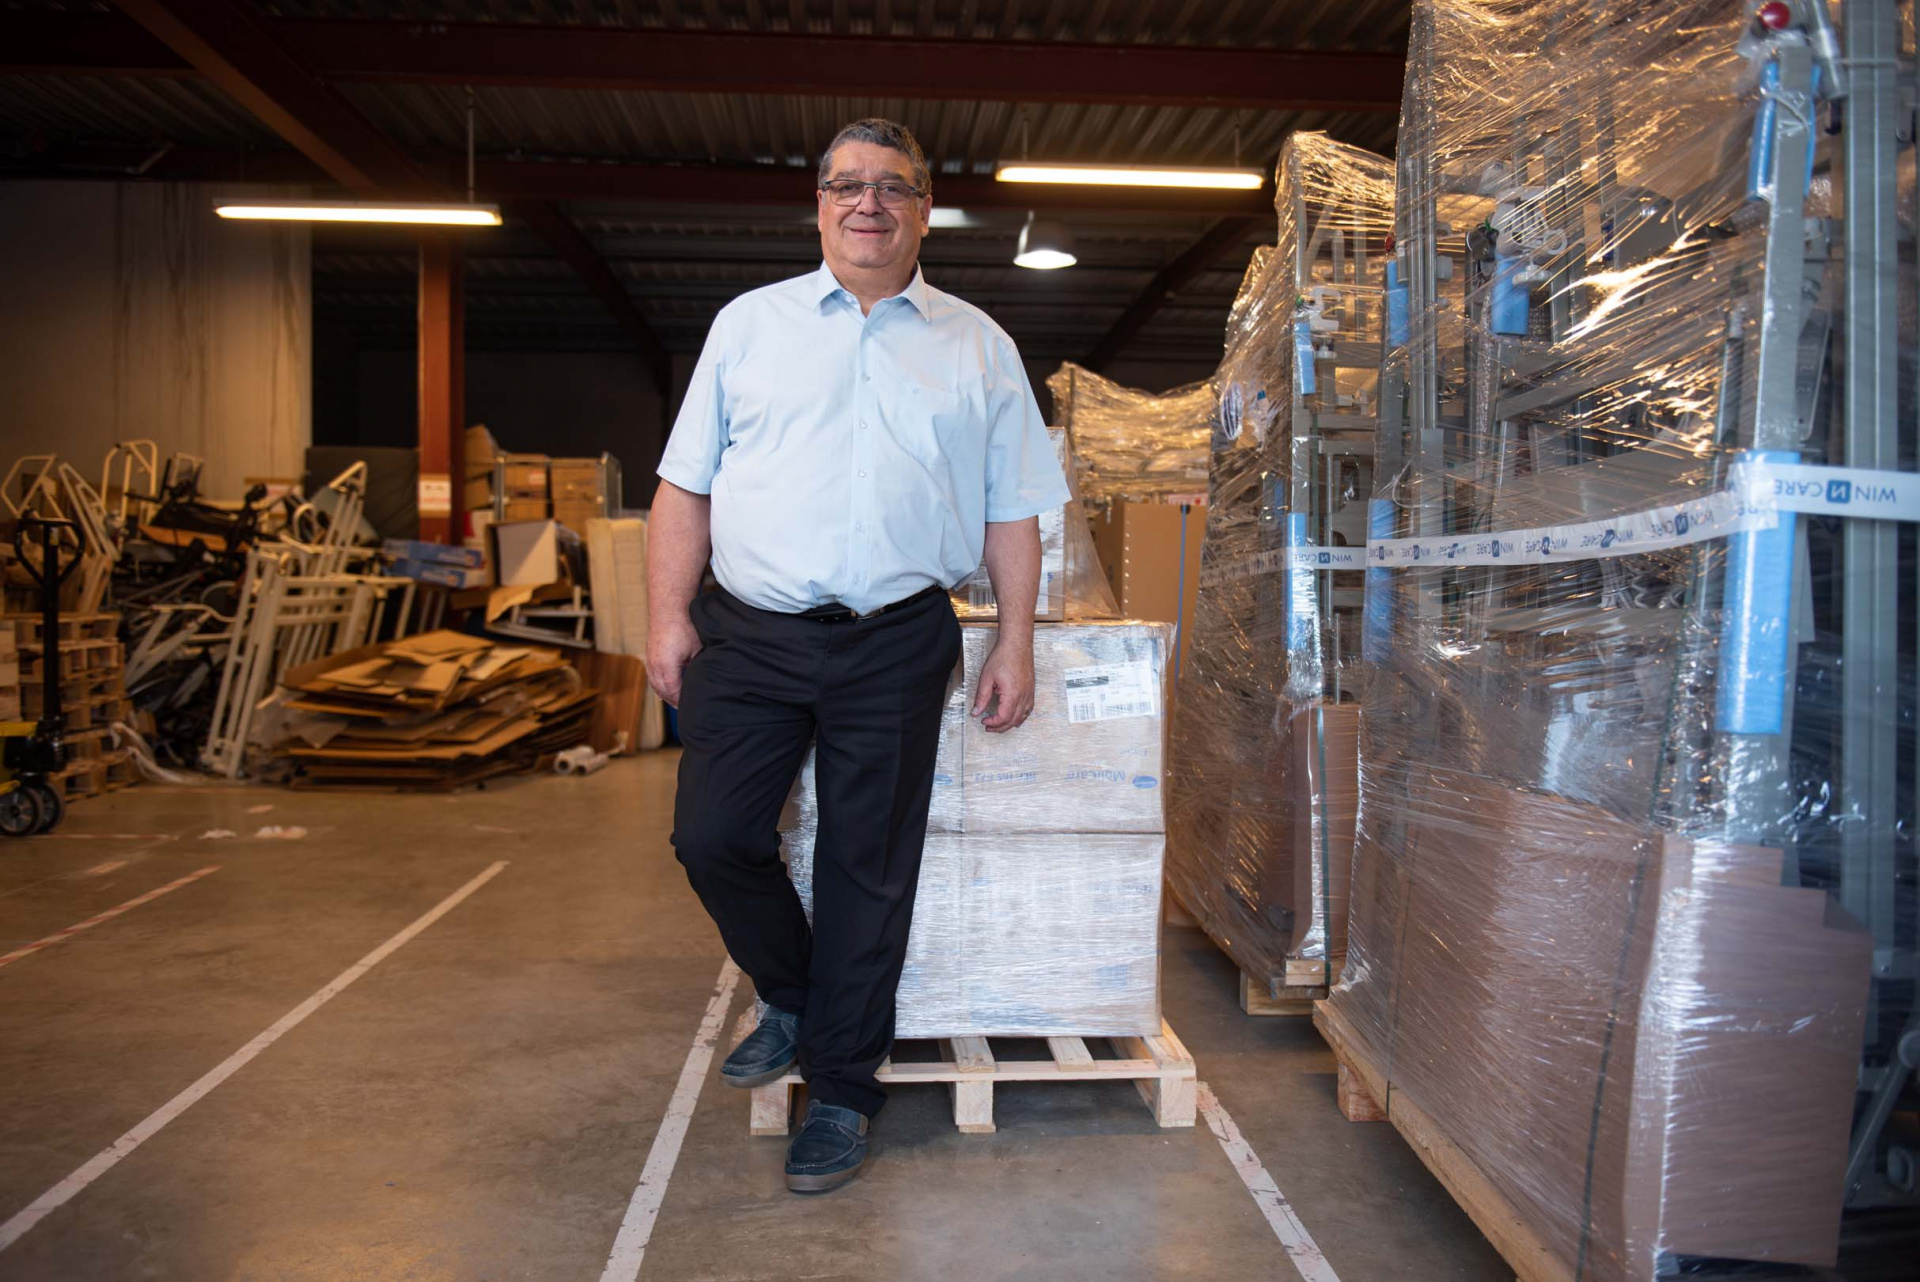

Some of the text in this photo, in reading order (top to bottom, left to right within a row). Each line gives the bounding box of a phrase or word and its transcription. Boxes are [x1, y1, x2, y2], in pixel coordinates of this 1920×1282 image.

[1773, 480, 1823, 498] CARE
[1854, 484, 1897, 503] WIN
[1476, 543, 1491, 554] CARE
[1331, 554, 1352, 563] WIN
